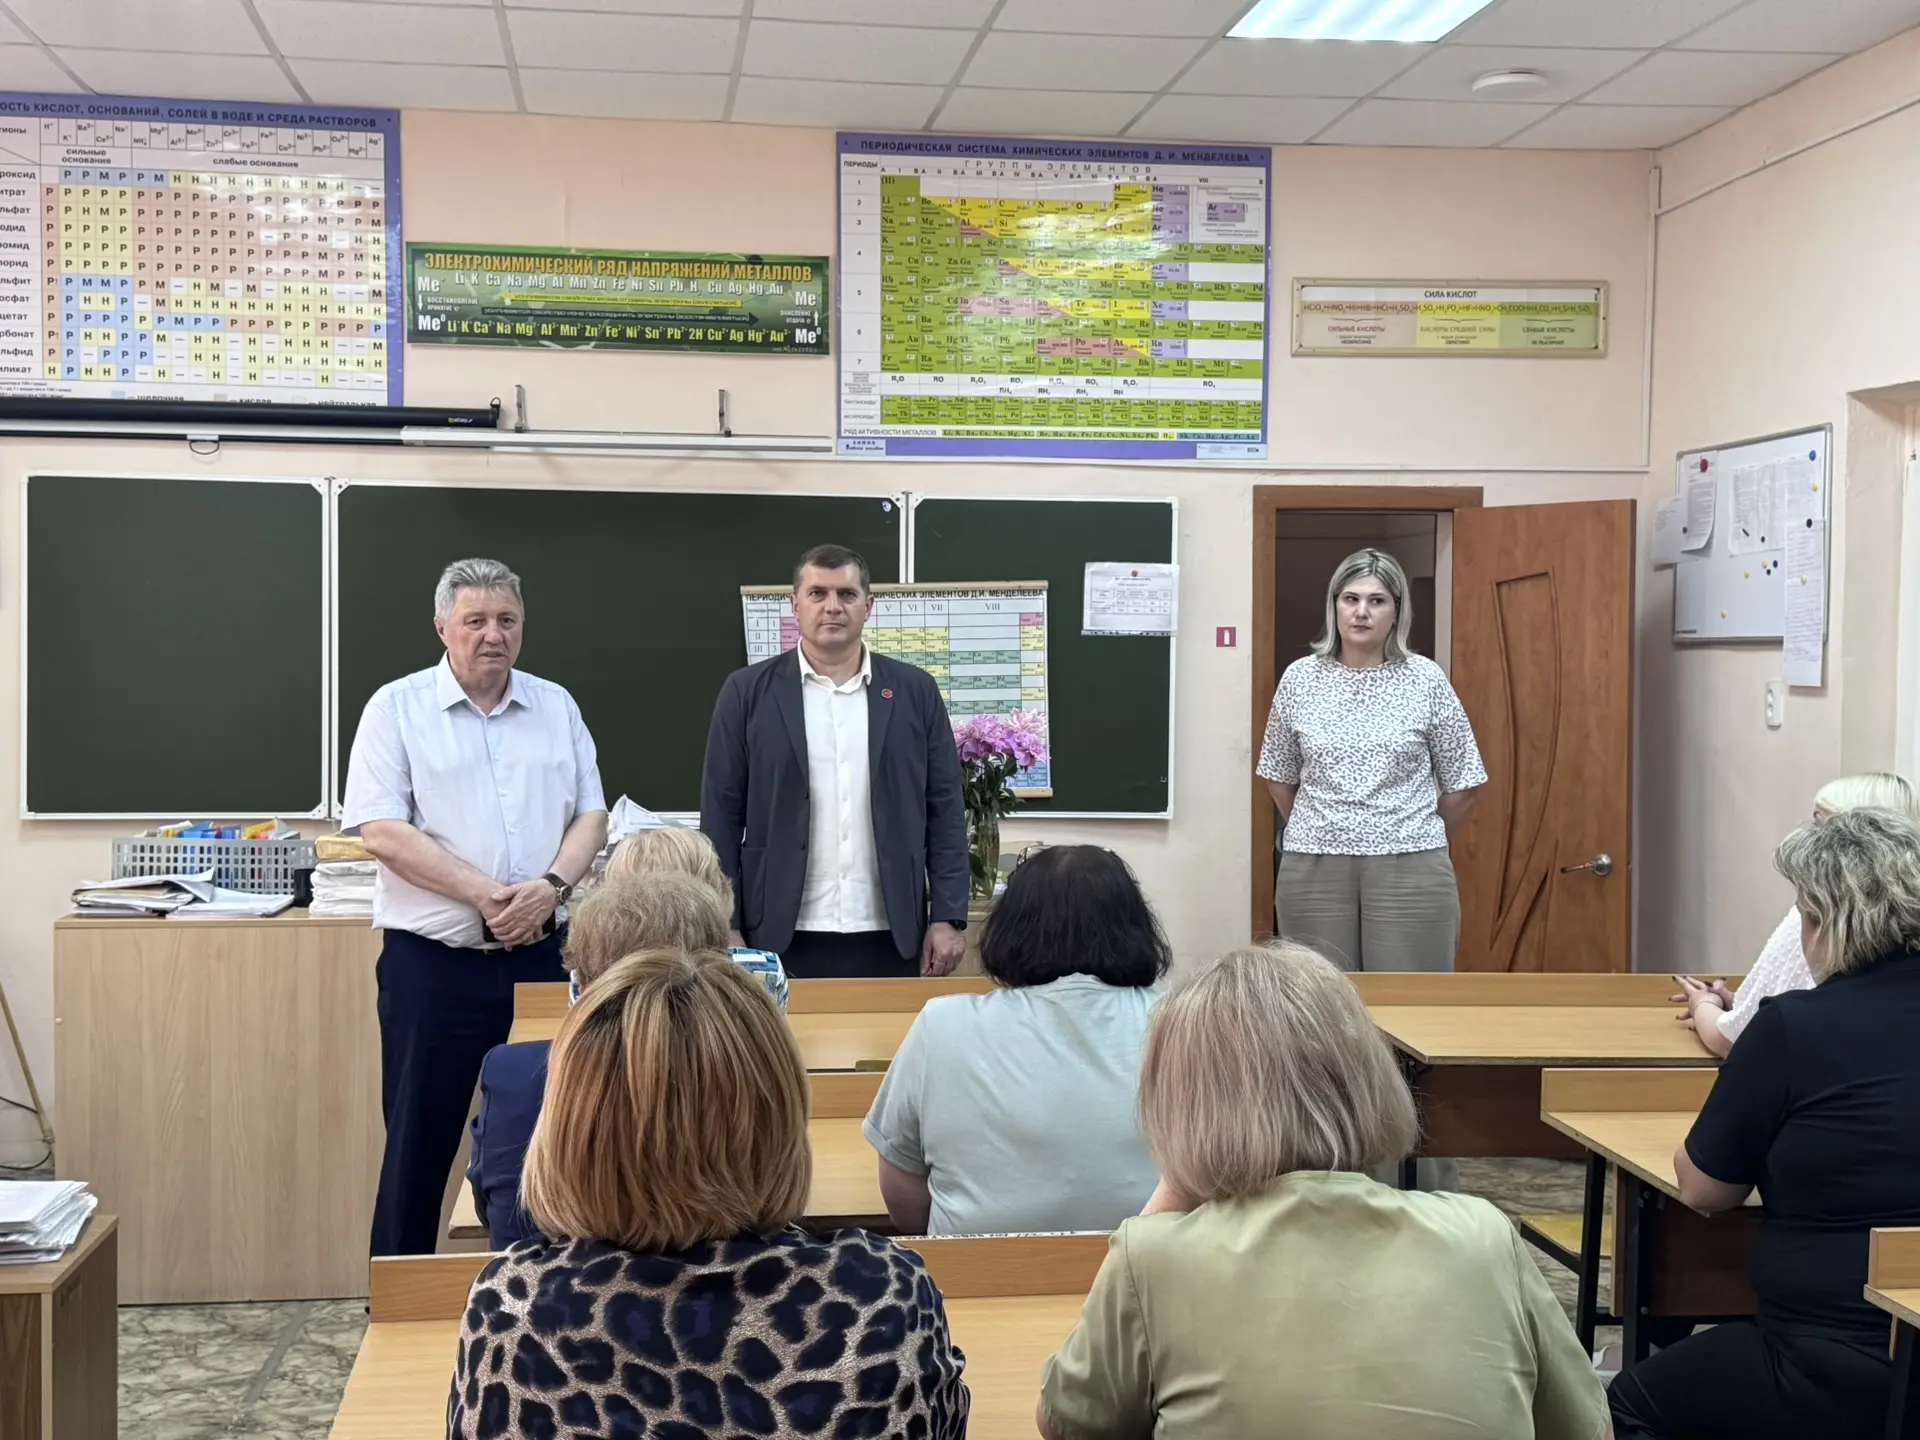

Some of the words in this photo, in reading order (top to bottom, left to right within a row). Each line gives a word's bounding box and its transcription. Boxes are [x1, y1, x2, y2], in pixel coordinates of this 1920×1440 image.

[33, 103, 84, 115] КИСЛОТ,
[88, 105, 164, 118] ОСНОВАНИЙ,
[167, 107, 208, 119] СОЛЕЙ
[211, 112, 218, 120] В
[222, 112, 252, 122] ВОДЕ
[256, 113, 264, 122] И
[267, 114, 305, 124] СРЕДА
[309, 116, 376, 127] РАСТВОРОВ
[861, 140, 952, 153] ПЕРИОДИЧЕСКАЯ
[957, 143, 1006, 154] СИСТЕМА
[1012, 146, 1082, 156] ХИМИЧЕСКИХ
[1088, 149, 1149, 160] ЭЛЕМЕНТОВ
[1182, 152, 1250, 162] МЕНДЕЛЕЕВА
[213, 158, 248, 166] слабые
[250, 160, 299, 168] основания
[843, 160, 878, 168] ПЕРИОДЫ
[882, 217, 894, 225] Na
[921, 218, 934, 226] Mg
[425, 253, 593, 275] ЭЛЕКТРОХИМИЧЕСКИЙ
[598, 259, 628, 278] РЯД
[632, 261, 731, 280] НАПРЯЖЕНИЙ
[734, 265, 812, 281] МЕТАЛЛОВ
[455, 272, 464, 283] Li
[471, 273, 479, 284] K
[486, 273, 500, 285] Ca
[508, 274, 522, 287] Na
[528, 275, 546, 288] Mg
[570, 276, 587, 288] Mn
[593, 277, 606, 289] Zn
[613, 279, 625, 290] Fe
[631, 279, 643, 290] Ni
[649, 280, 663, 291] Sn
[670, 280, 683, 292] Pb
[708, 281, 722, 293] Cu
[728, 282, 743, 295] Ag
[749, 282, 763, 296] Hg
[770, 283, 784, 295] Au
[1424, 290, 1445, 298] СИЛА
[1446, 290, 1477, 298] КИСЛОТ
[859, 428, 901, 436] АКТИВНОСТИ
[920, 590, 969, 598] ЭЛЕМЕНТОВ
[989, 589, 1044, 598] МЕНДЕЛЕЕВА
[885, 604, 892, 612] V
[908, 604, 917, 612] VI
[931, 604, 943, 612] VII
[985, 603, 1000, 611] VIII
[754, 645, 763, 653] III
